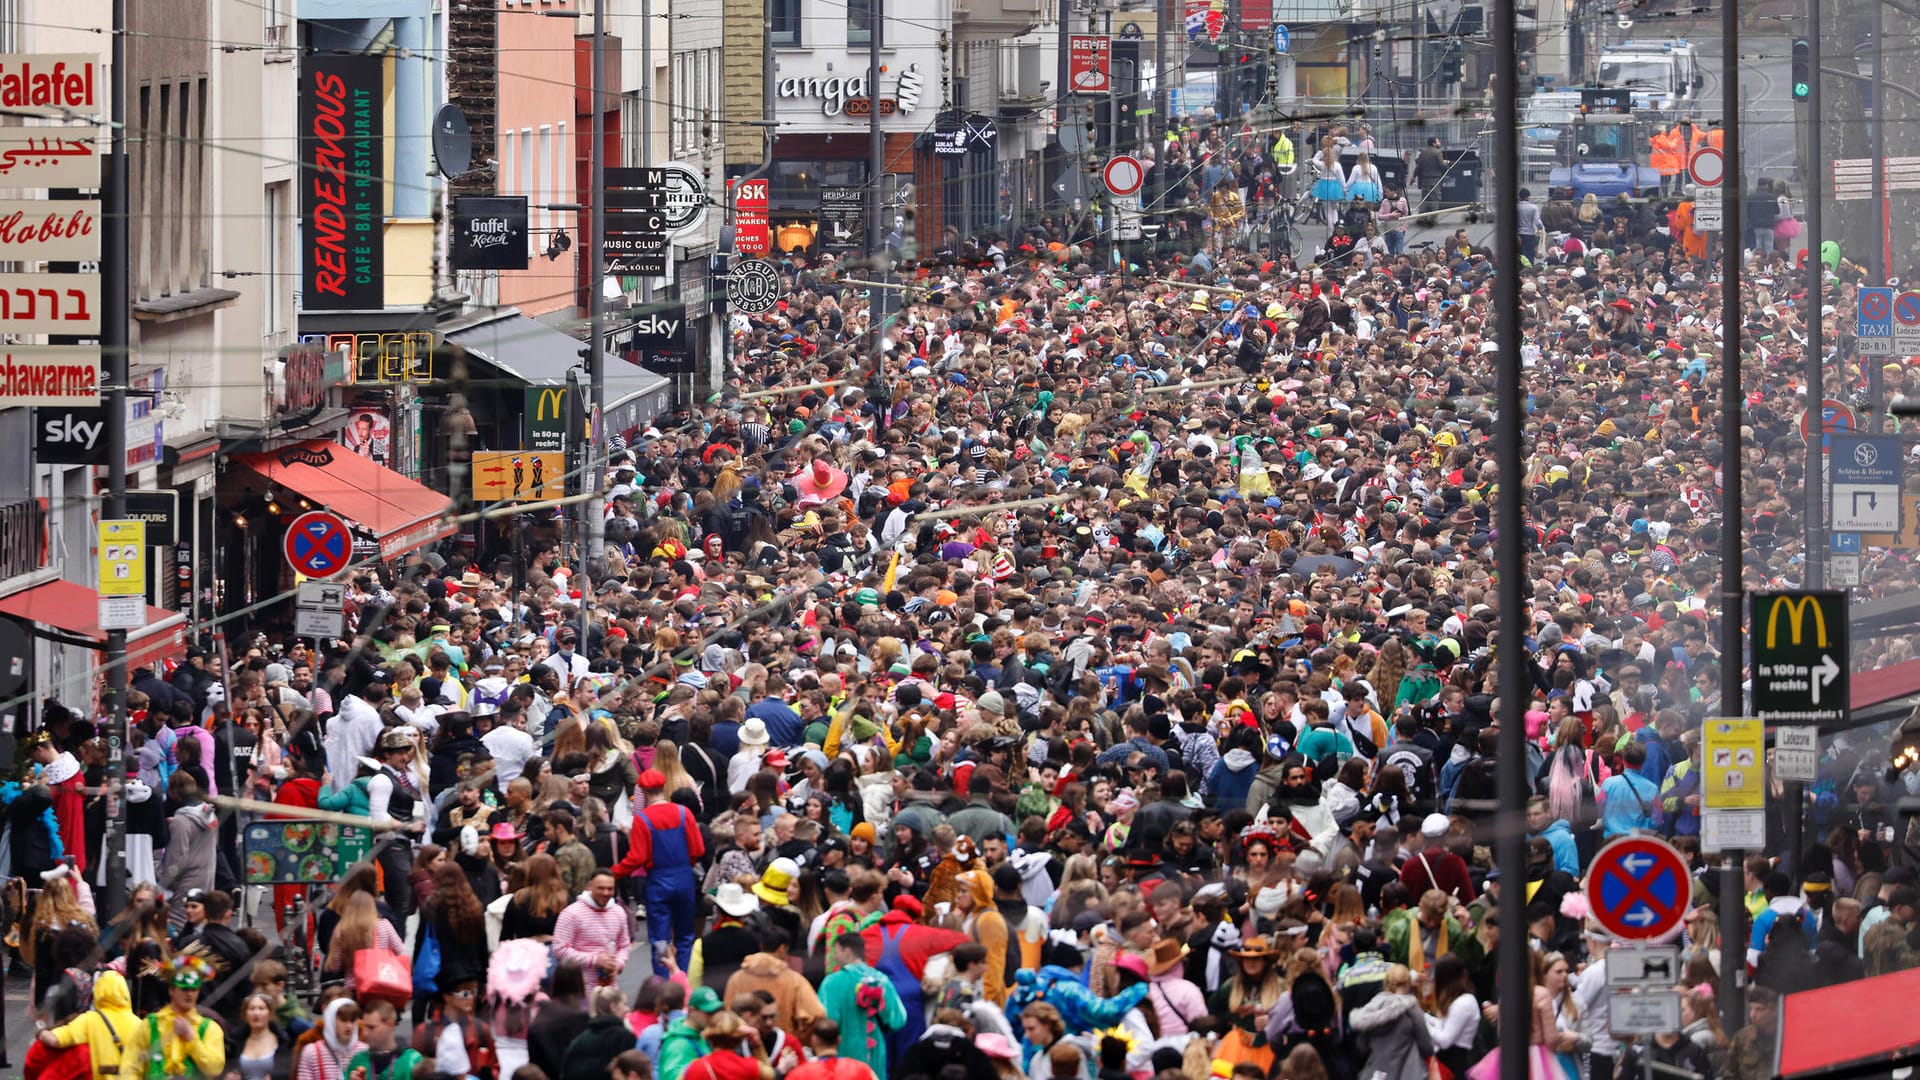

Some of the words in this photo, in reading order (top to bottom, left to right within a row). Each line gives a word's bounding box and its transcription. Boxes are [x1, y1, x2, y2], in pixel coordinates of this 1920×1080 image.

[0, 62, 93, 107] alafel
[851, 101, 891, 113] DÖER
[354, 89, 371, 188] RESTAURANT
[314, 70, 346, 297] RENDEZVOUS
[355, 202, 371, 232] BAR
[471, 218, 510, 233] Gaffel
[635, 241, 661, 249] CLUB
[353, 245, 371, 285] CAFÉ
[639, 314, 680, 339] sky
[1861, 324, 1889, 336] TAXI
[45, 413, 104, 450] sky
[125, 512, 168, 523] OLOURS
[1759, 664, 1771, 676] in
[1773, 664, 1795, 676] 100
[1796, 665, 1808, 676] m
[1769, 680, 1808, 691] rechts
[233, 746, 253, 757] OLICE
